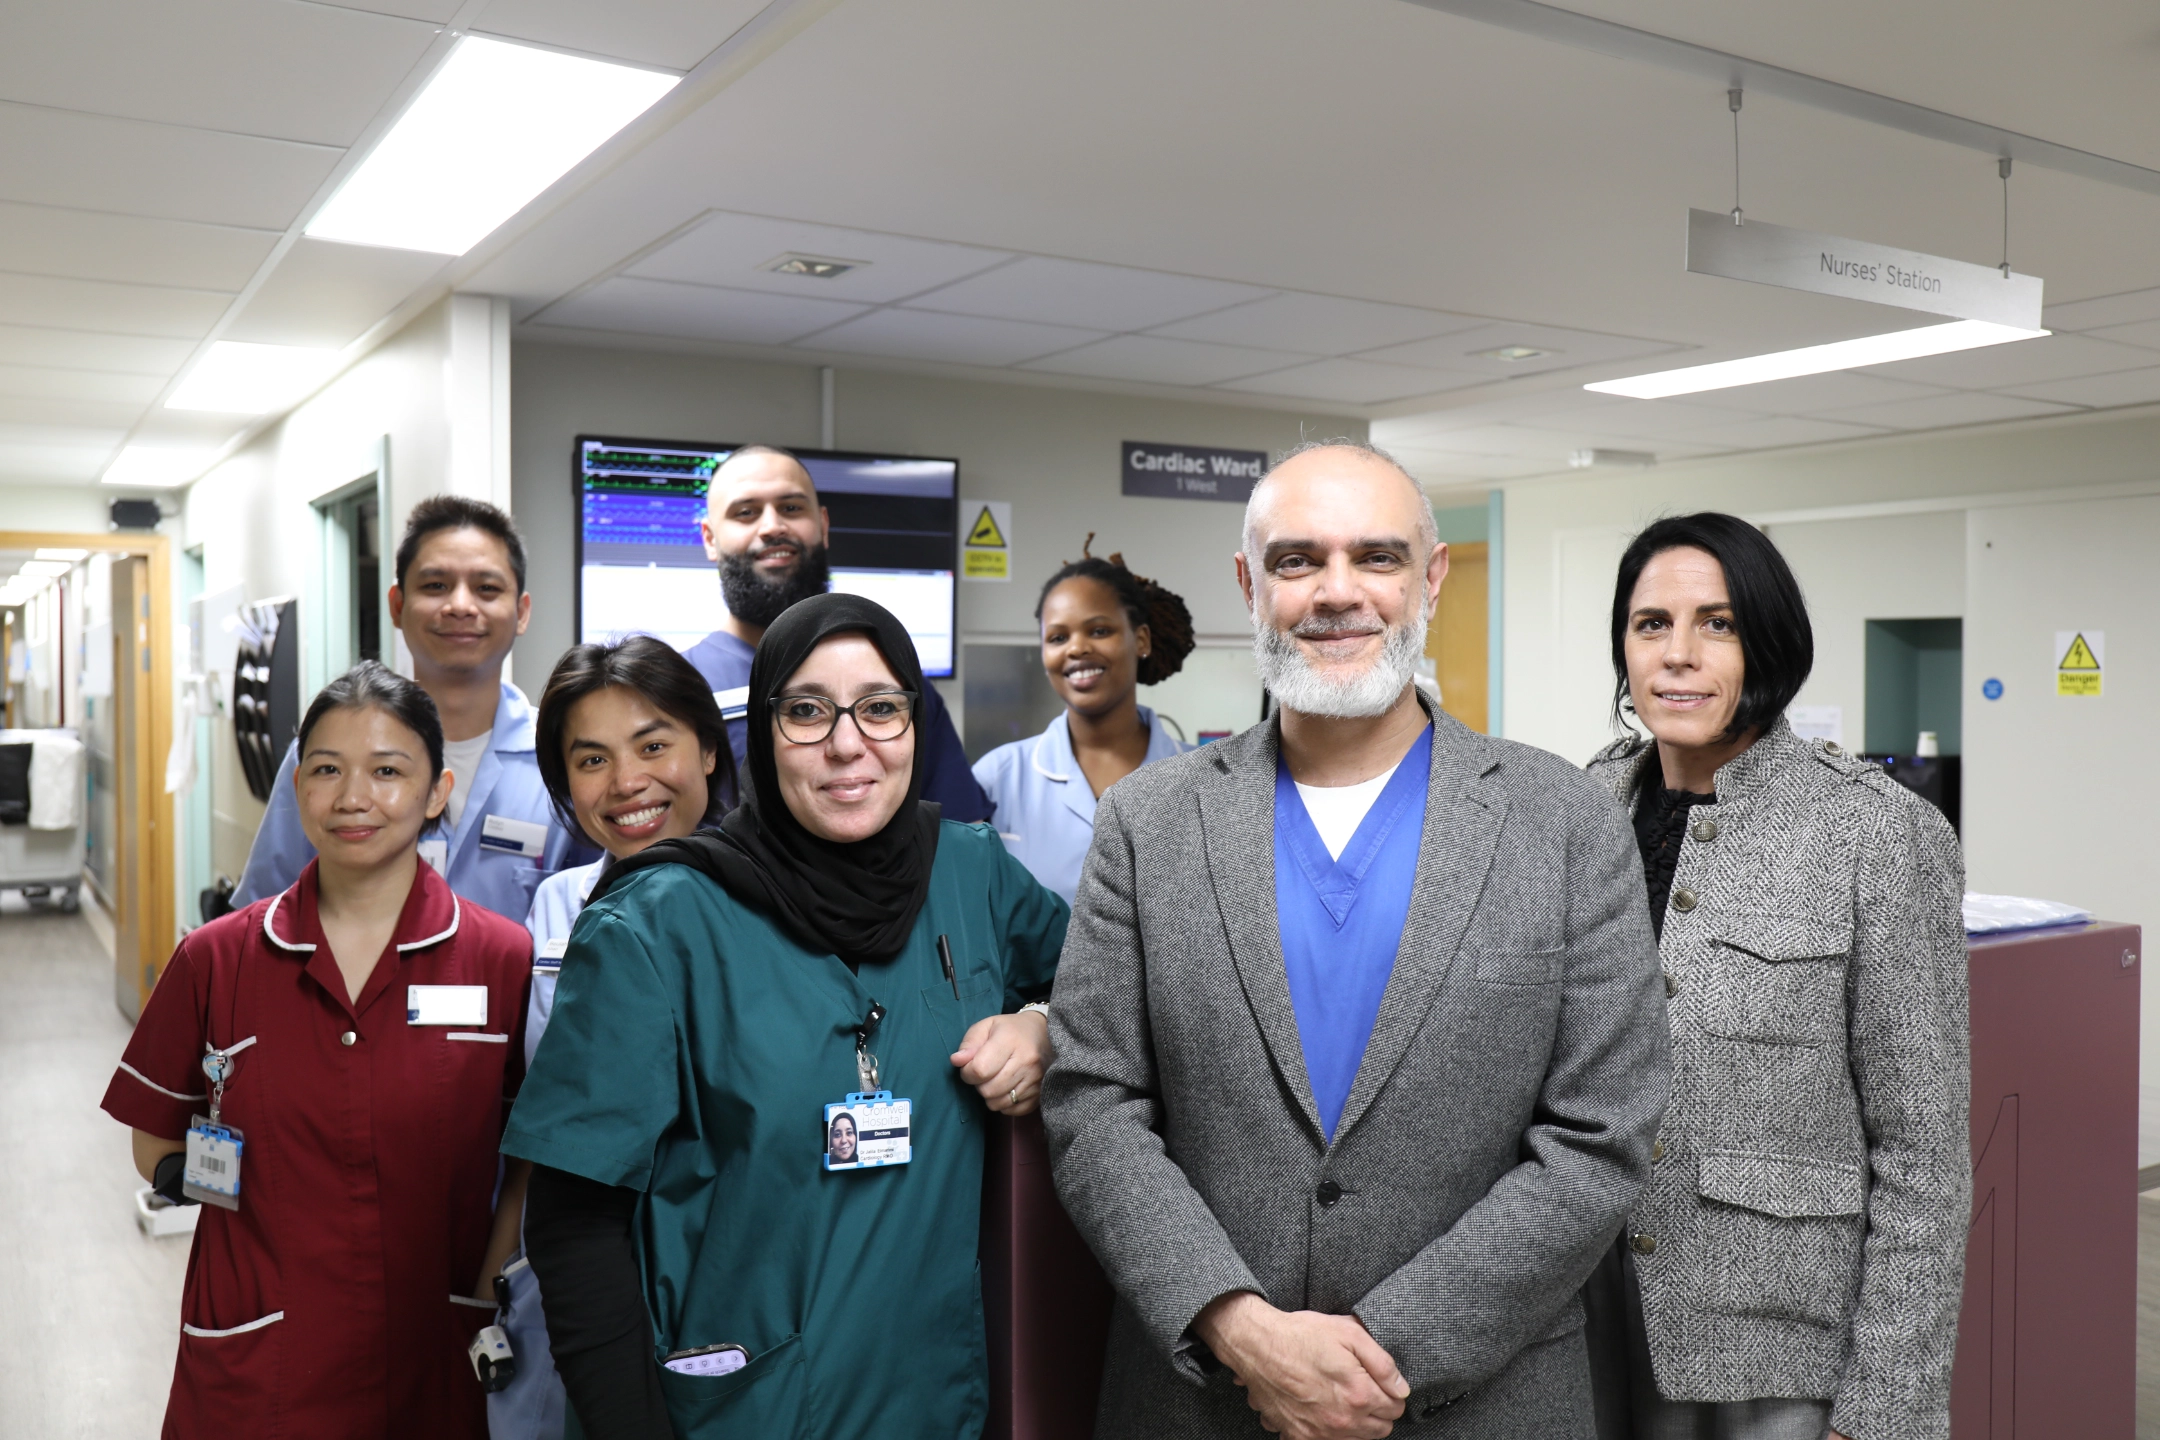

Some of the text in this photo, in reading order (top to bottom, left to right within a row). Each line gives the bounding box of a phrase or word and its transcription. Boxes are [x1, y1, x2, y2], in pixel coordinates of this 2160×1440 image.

[1819, 252, 1942, 294] Nurses' Station
[1130, 450, 1262, 478] Cardiac Ward
[2060, 673, 2099, 684] Danger
[862, 1103, 908, 1117] Cromwell
[862, 1114, 902, 1127] Hospital
